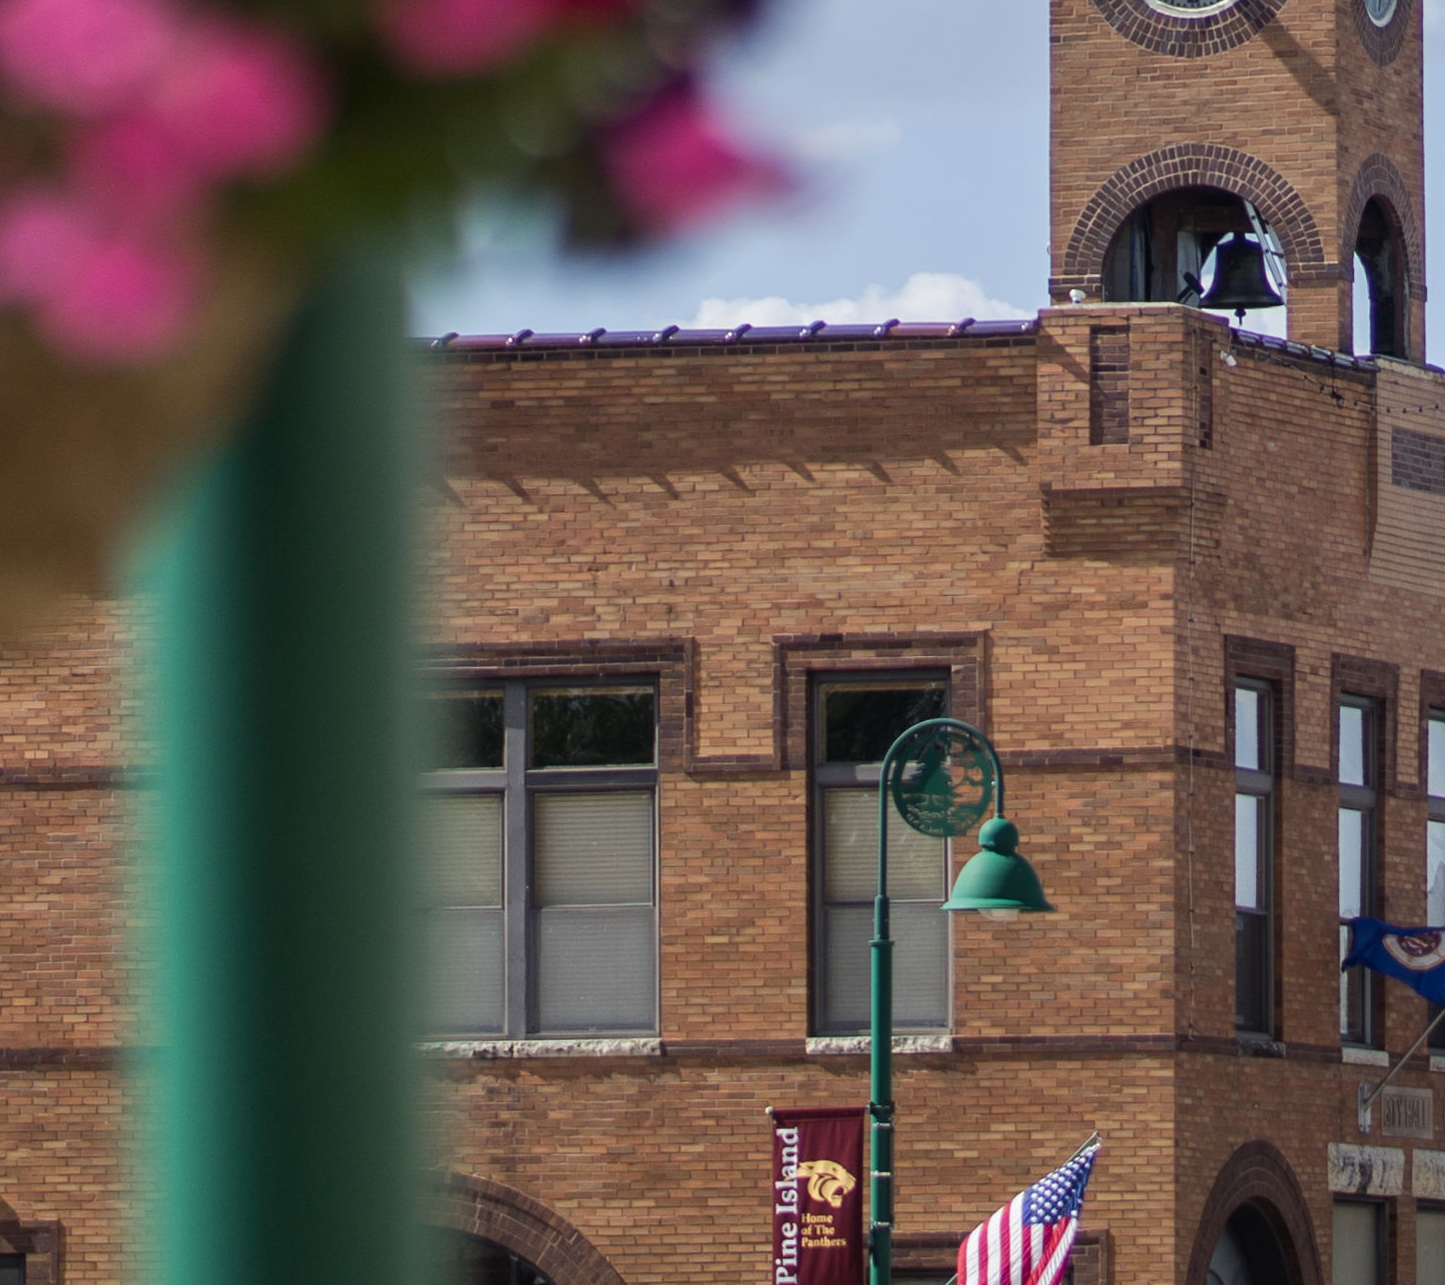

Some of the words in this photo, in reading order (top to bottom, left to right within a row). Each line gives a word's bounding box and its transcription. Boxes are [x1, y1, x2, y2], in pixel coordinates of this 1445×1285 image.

[775, 1126, 798, 1215] Island
[801, 1213, 833, 1224] Home
[801, 1224, 812, 1236] of
[814, 1224, 835, 1235] The
[802, 1236, 846, 1247] Panthers
[775, 1222, 798, 1285] Pine
